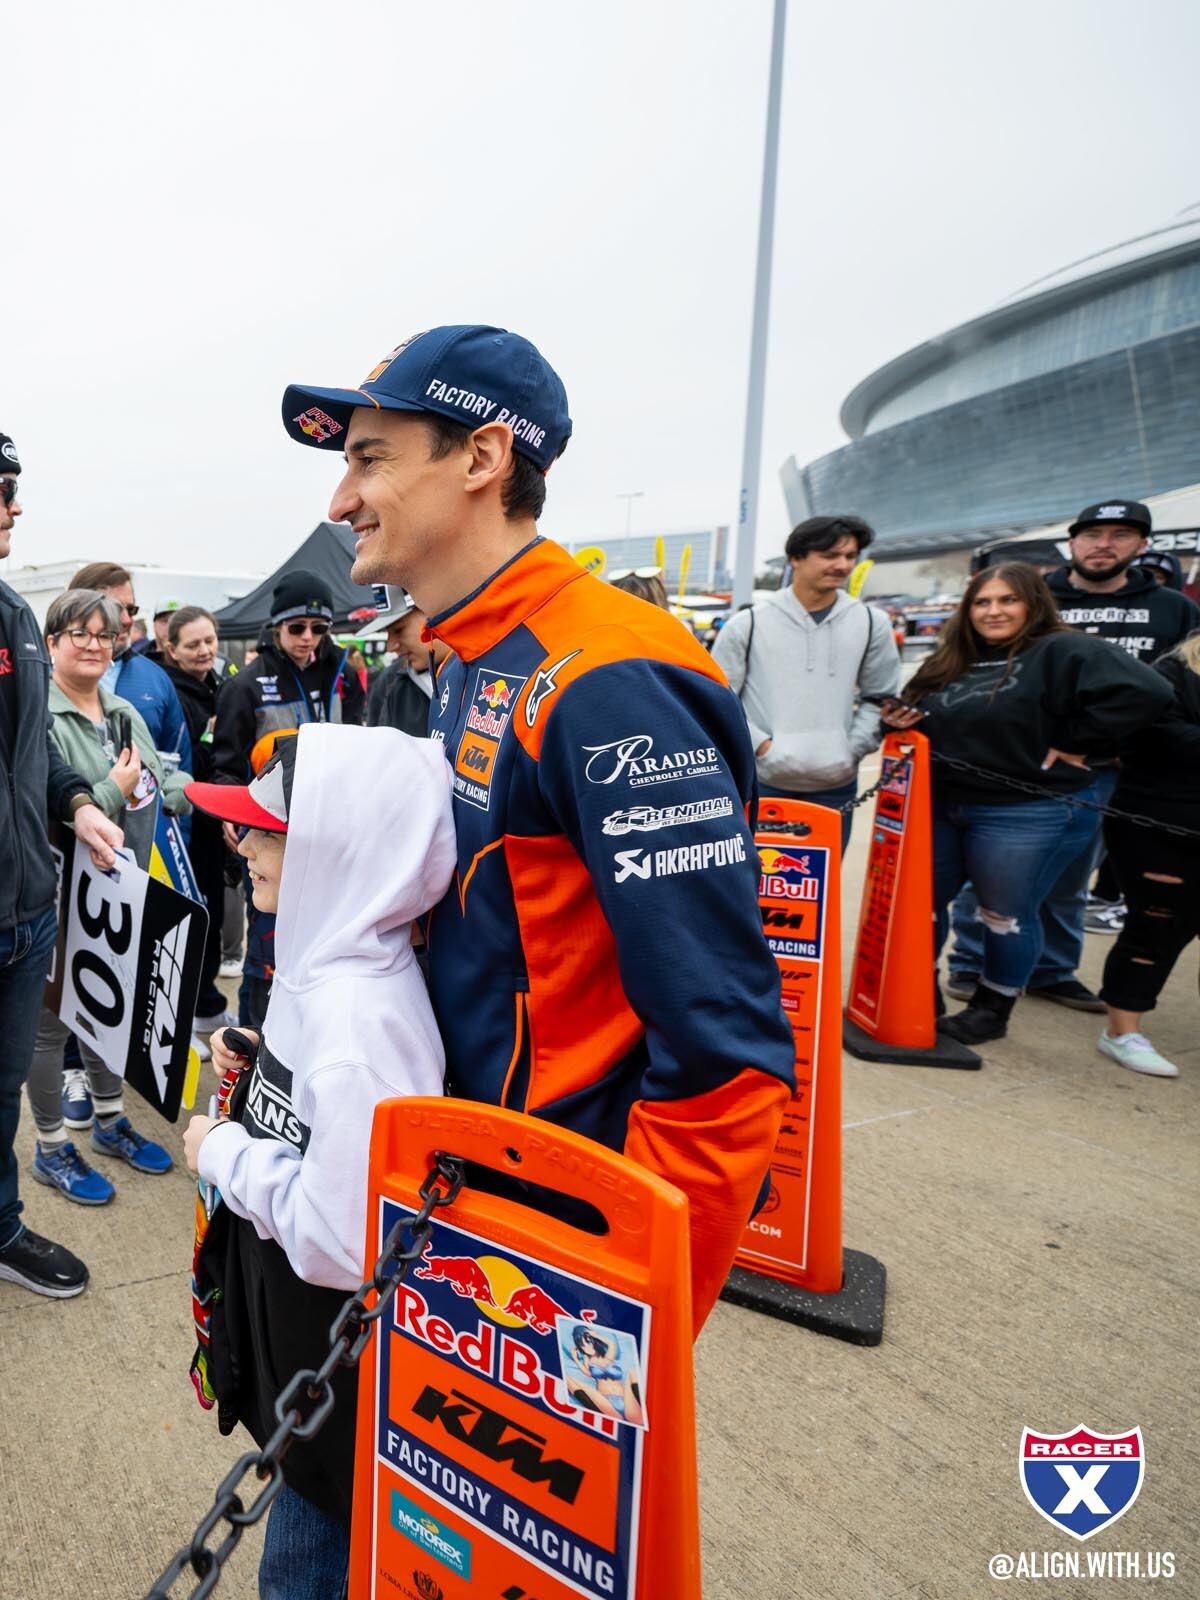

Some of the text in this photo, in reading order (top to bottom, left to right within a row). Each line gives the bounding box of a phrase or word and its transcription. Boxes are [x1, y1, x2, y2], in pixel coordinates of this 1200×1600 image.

[426, 379, 546, 449] FACTORY RACING
[1058, 607, 1150, 624] OTOCROSS
[462, 745, 491, 773] KTM
[582, 735, 718, 784] PARADISE
[629, 765, 720, 786] CHEVROLET CADILLAC
[465, 783, 488, 803] RACING
[646, 797, 731, 822] RENTHAL
[768, 875, 819, 900] Bull
[760, 906, 804, 930] TM
[71, 869, 132, 1028] 30
[768, 939, 816, 956] RACING
[150, 913, 192, 1104] FLY
[249, 1067, 303, 1144] VANS
[404, 1108, 638, 1200] ULTRA PANEL
[746, 1220, 782, 1238] .COM
[394, 1282, 618, 1441] Red Bu
[412, 1384, 585, 1505] KTM
[387, 1429, 615, 1593] FACTORY RACING
[399, 1508, 463, 1564] MOTOREX
